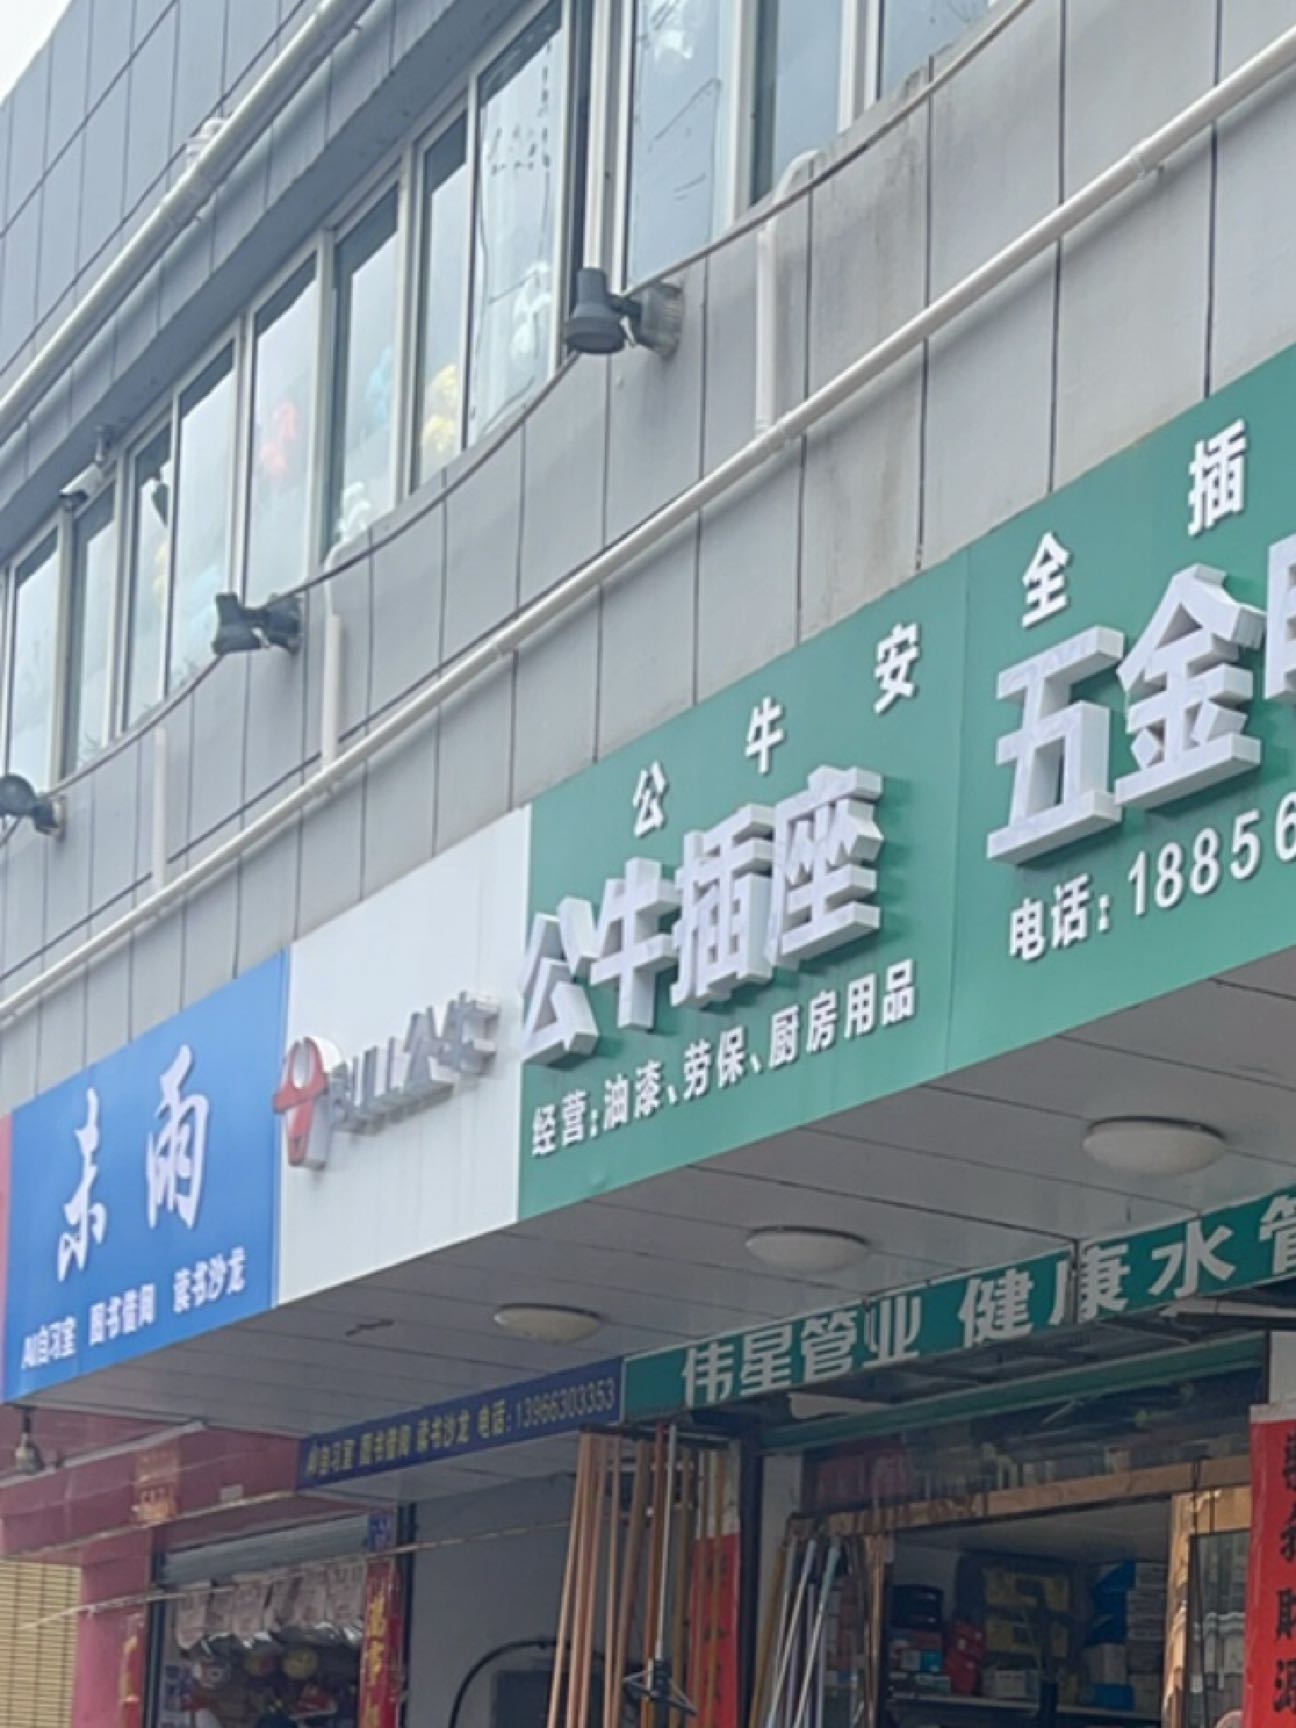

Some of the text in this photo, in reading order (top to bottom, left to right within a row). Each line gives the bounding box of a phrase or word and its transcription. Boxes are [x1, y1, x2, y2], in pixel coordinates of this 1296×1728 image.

[517, 765, 884, 1066] 公牛插座
[682, 1291, 924, 1411] 伟星管业
